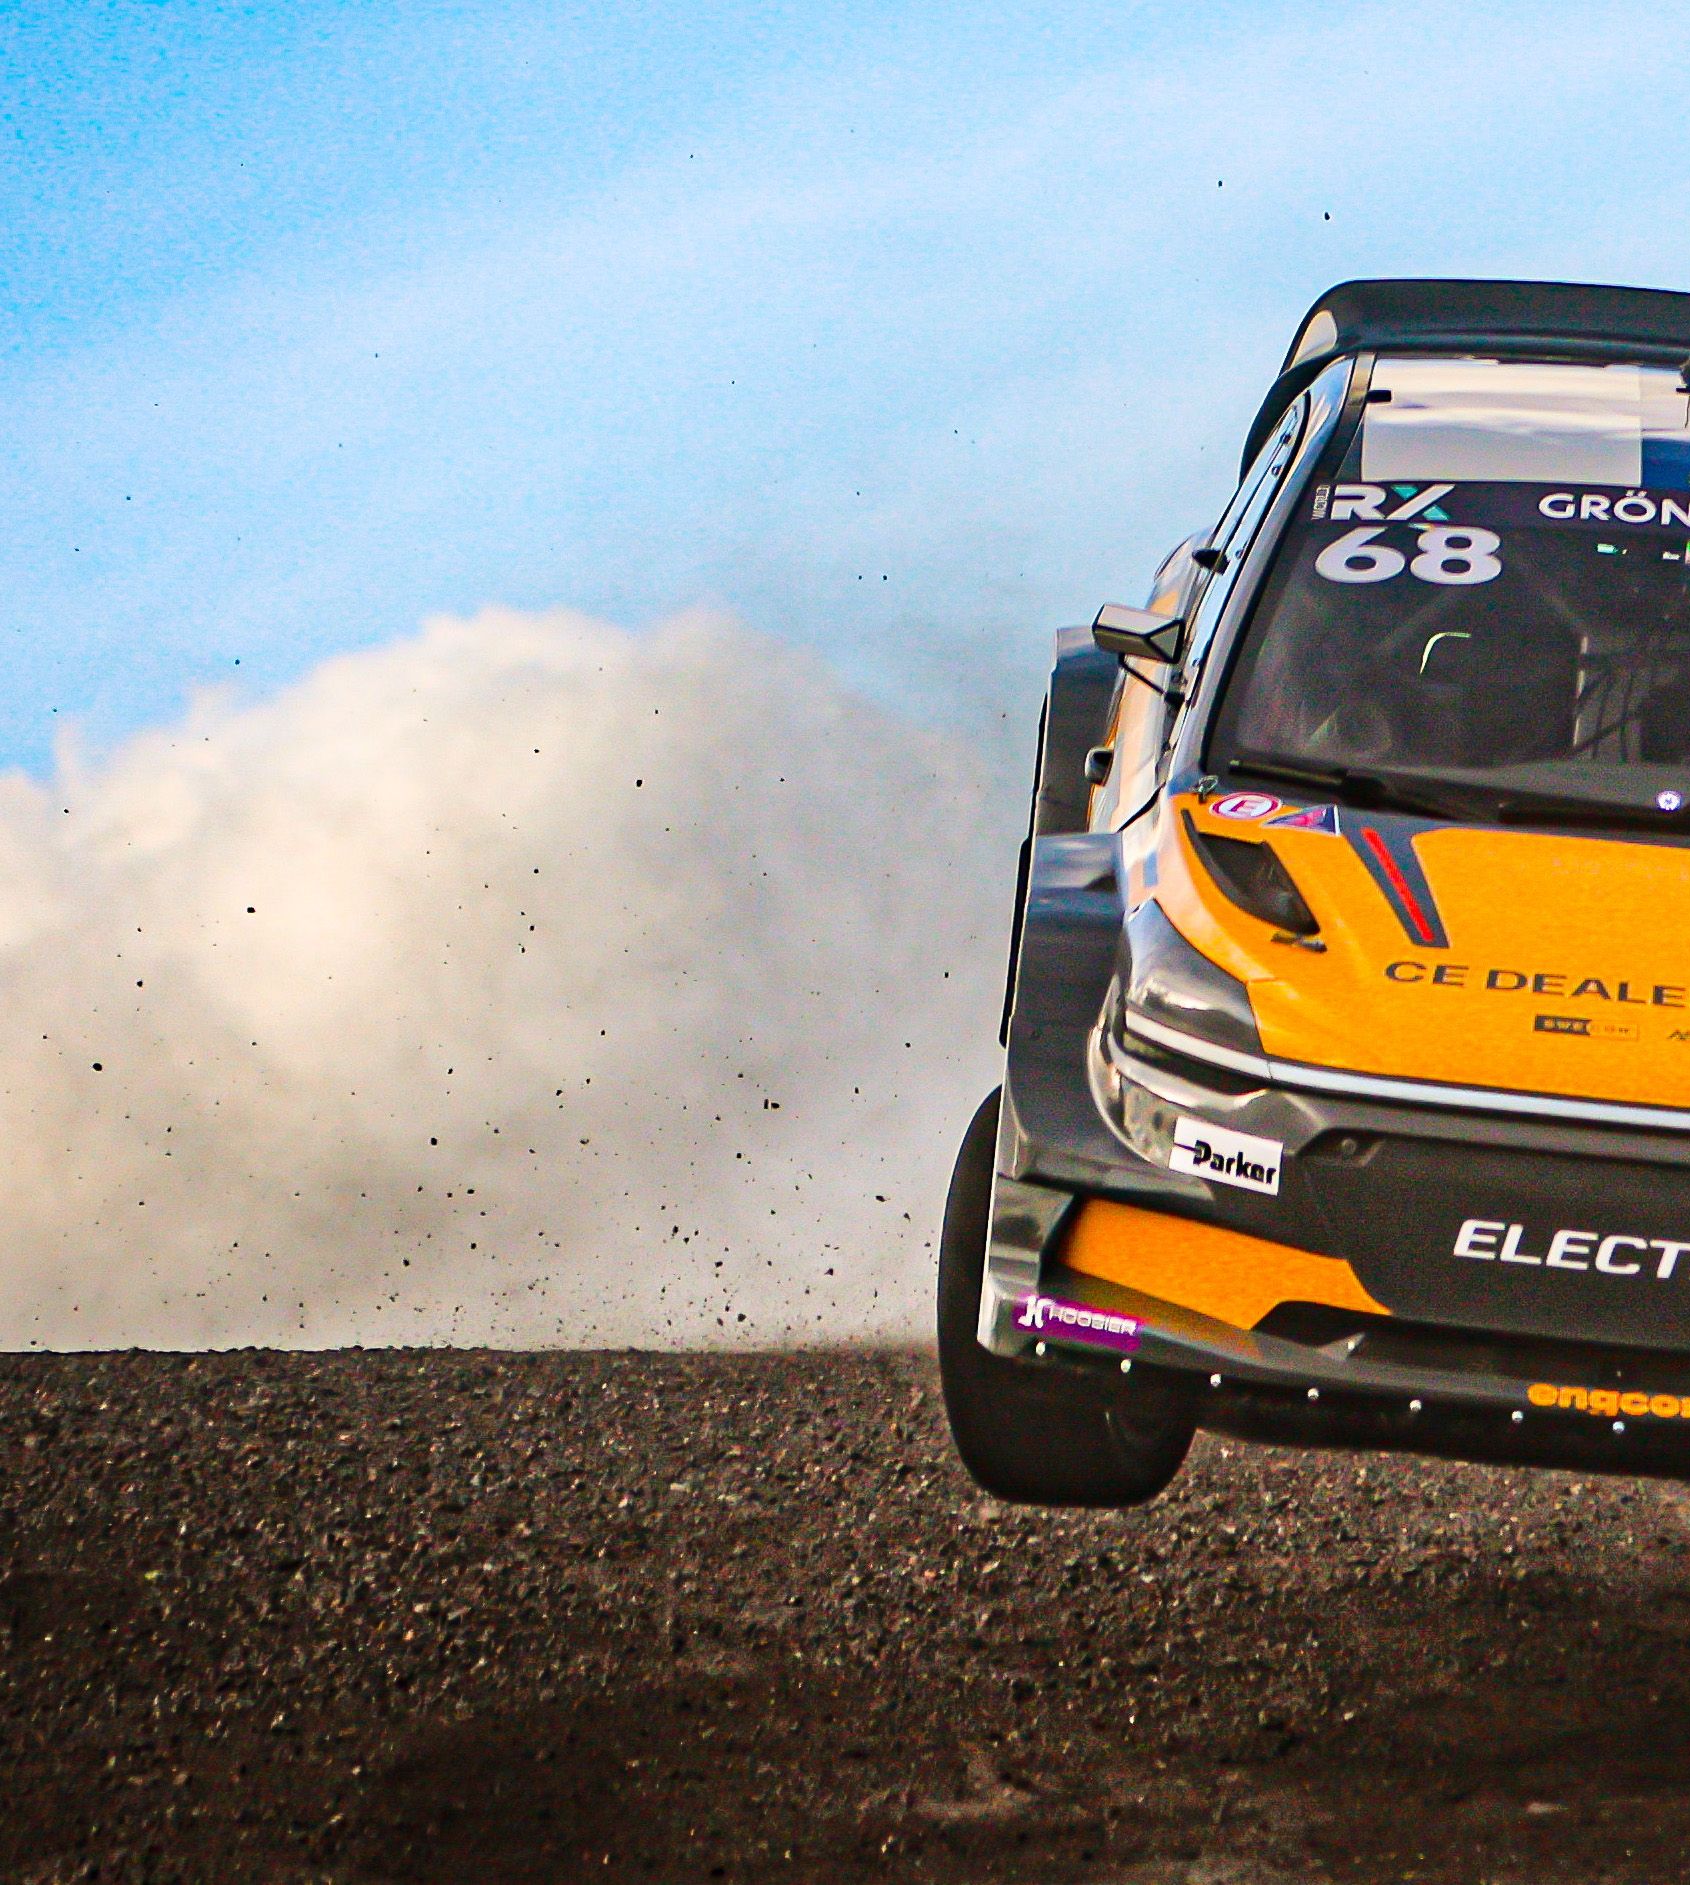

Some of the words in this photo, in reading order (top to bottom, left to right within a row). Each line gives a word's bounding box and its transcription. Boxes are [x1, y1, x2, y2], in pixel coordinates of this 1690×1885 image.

[1331, 484, 1455, 520] RX
[1315, 526, 1502, 584] 68
[1385, 961, 1469, 987] CE
[1192, 1140, 1277, 1184] Parker
